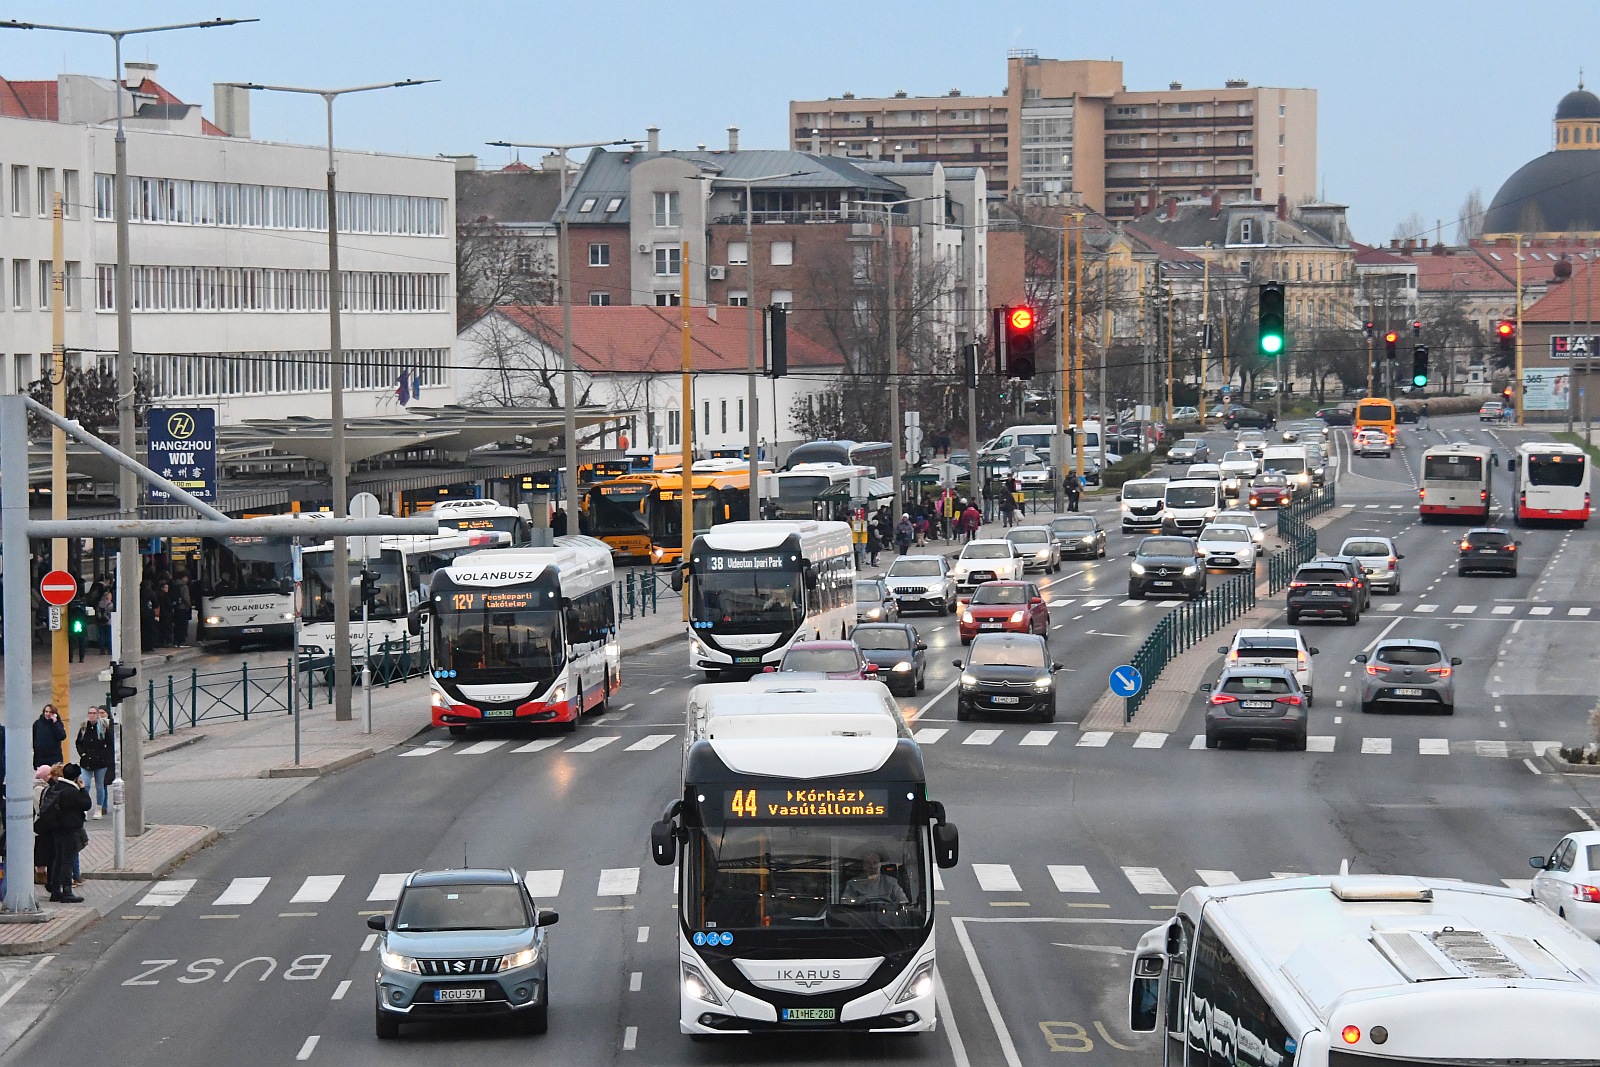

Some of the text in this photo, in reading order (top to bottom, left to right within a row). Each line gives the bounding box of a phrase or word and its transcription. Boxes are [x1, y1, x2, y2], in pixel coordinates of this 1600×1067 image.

[1526, 374, 1542, 384] 365
[151, 440, 212, 451] HANGZHOU
[168, 452, 195, 465] WOK
[711, 556, 724, 570] 38
[768, 556, 783, 568] Park
[452, 593, 474, 610] 12Y
[731, 789, 856, 817] 44 Kórház
[768, 802, 885, 815] Vasútállomás
[121, 954, 332, 986] BUSZ
[777, 970, 841, 979] IKARUS
[441, 990, 483, 999] RGU-971
